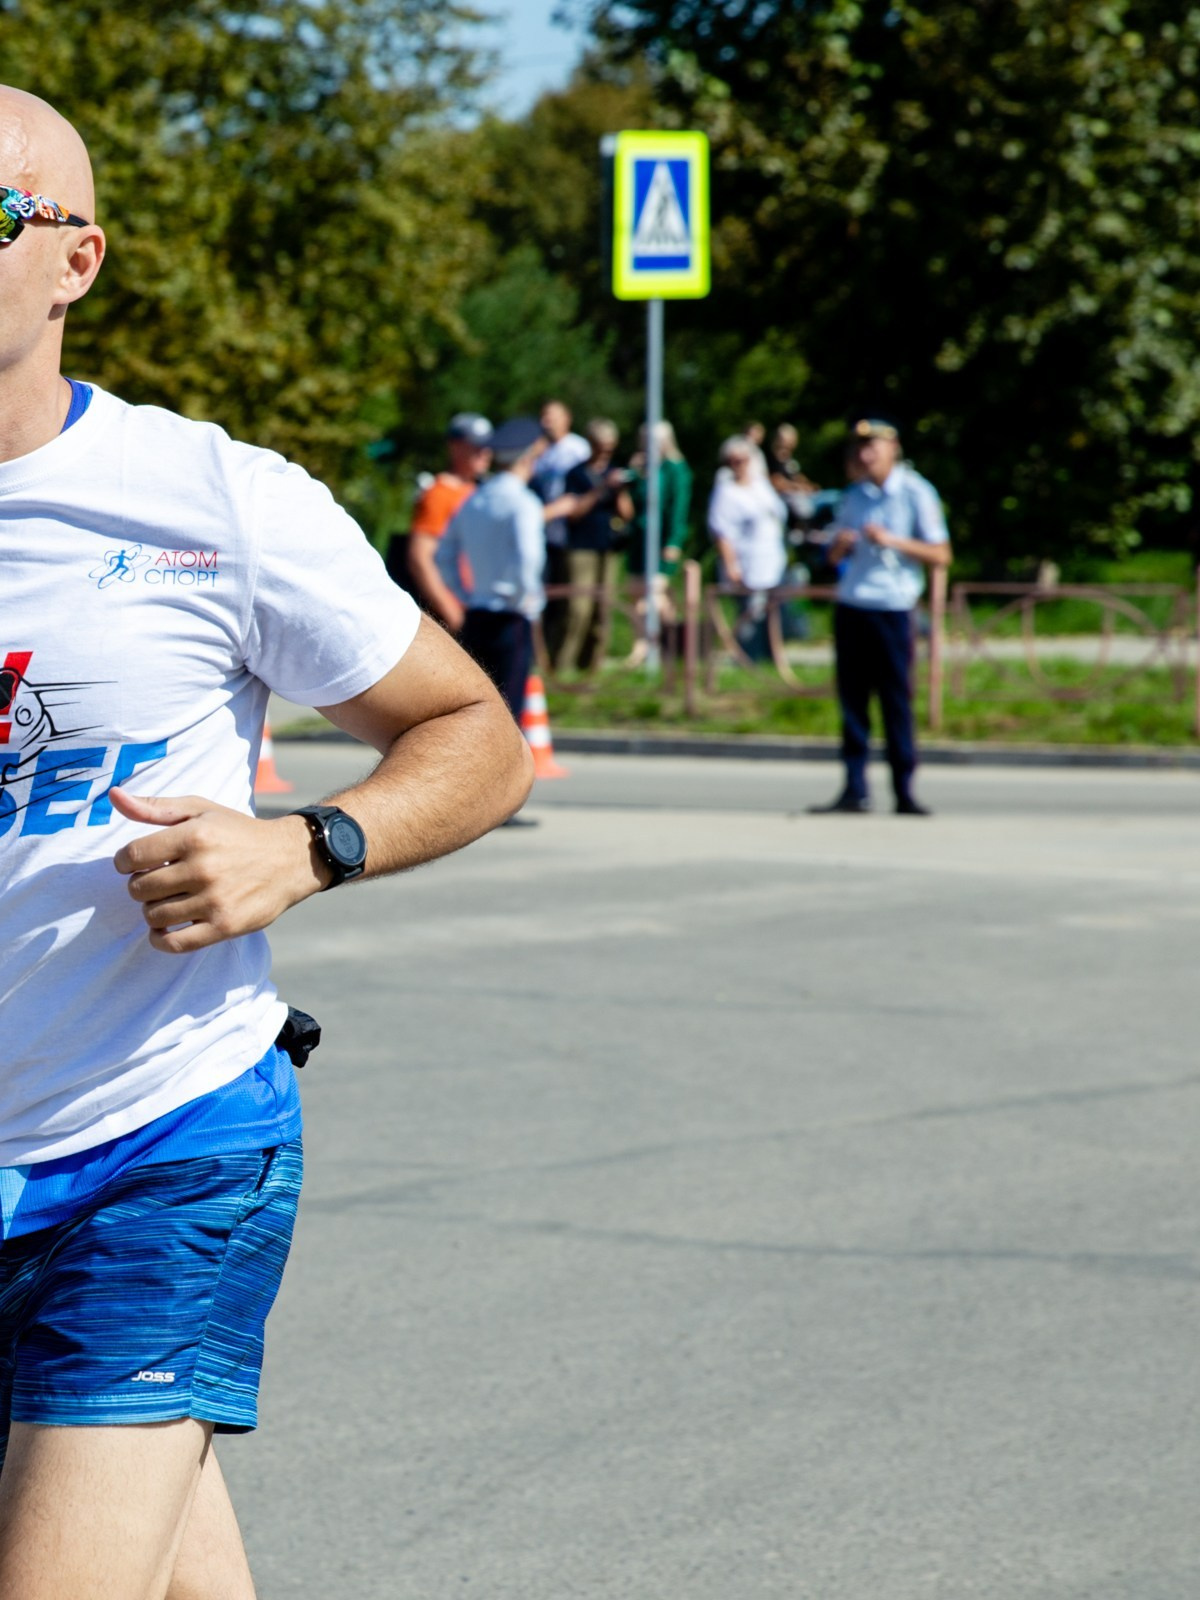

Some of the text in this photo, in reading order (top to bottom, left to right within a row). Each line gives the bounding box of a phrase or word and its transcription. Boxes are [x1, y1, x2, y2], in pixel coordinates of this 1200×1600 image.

[155, 551, 217, 568] АТОМ
[144, 569, 219, 587] СПОРТ
[131, 1370, 175, 1383] JOSS
